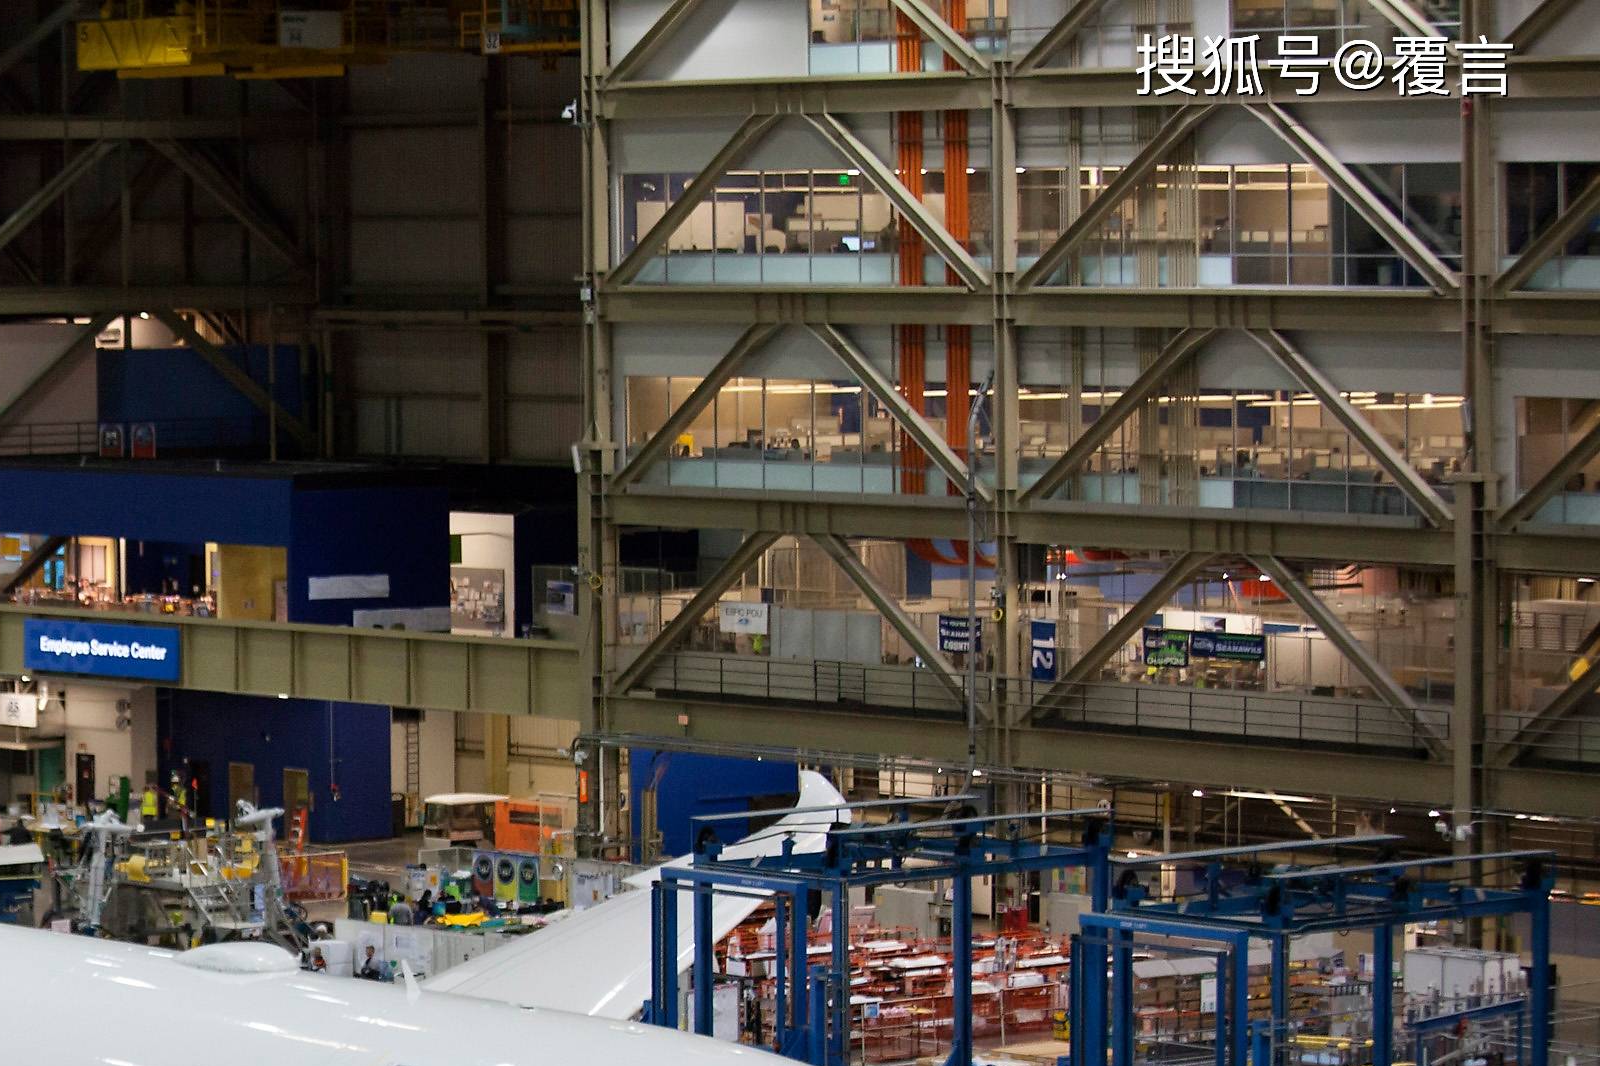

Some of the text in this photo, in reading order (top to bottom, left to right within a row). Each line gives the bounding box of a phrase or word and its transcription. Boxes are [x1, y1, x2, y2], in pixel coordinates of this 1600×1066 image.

[39, 635, 167, 661] Employee Service Center
[1032, 638, 1055, 669] 12
[1215, 643, 1262, 654] SEAHAWKS
